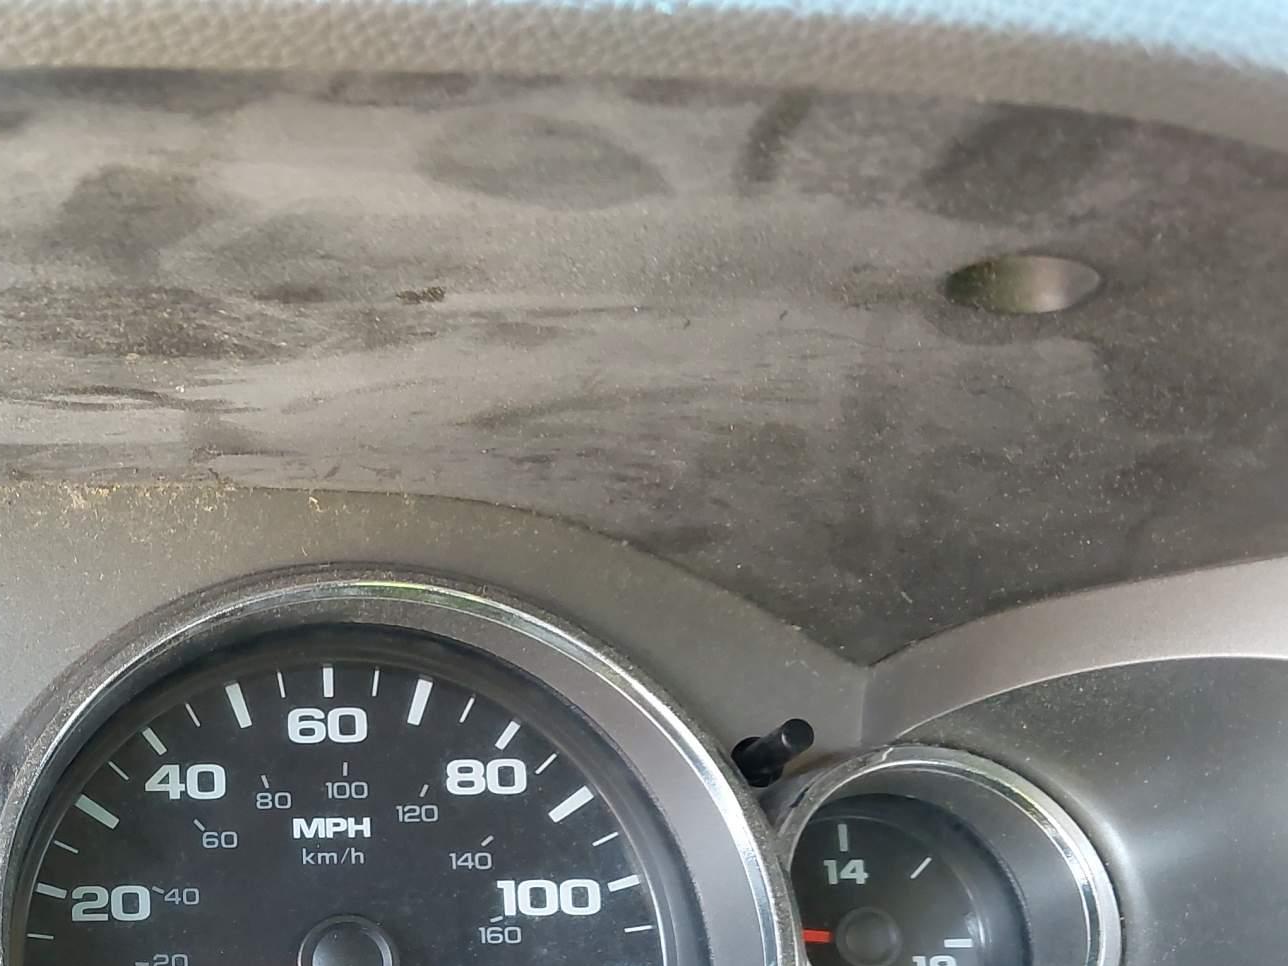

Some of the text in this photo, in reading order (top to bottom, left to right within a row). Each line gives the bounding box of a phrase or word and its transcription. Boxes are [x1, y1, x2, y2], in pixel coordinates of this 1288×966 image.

[287, 706, 369, 744] 60
[144, 763, 227, 800] 40
[445, 757, 527, 795] 80
[256, 791, 292, 810] 80
[324, 781, 370, 800] 100
[395, 804, 440, 823] 120
[292, 816, 372, 839] MPH
[201, 830, 238, 849] 60
[302, 847, 365, 865] km/h
[448, 851, 493, 871] 140
[823, 858, 870, 885] 14
[70, 884, 152, 922] 20
[163, 887, 200, 906] 40
[496, 878, 602, 917] 100
[478, 925, 522, 945] 160
